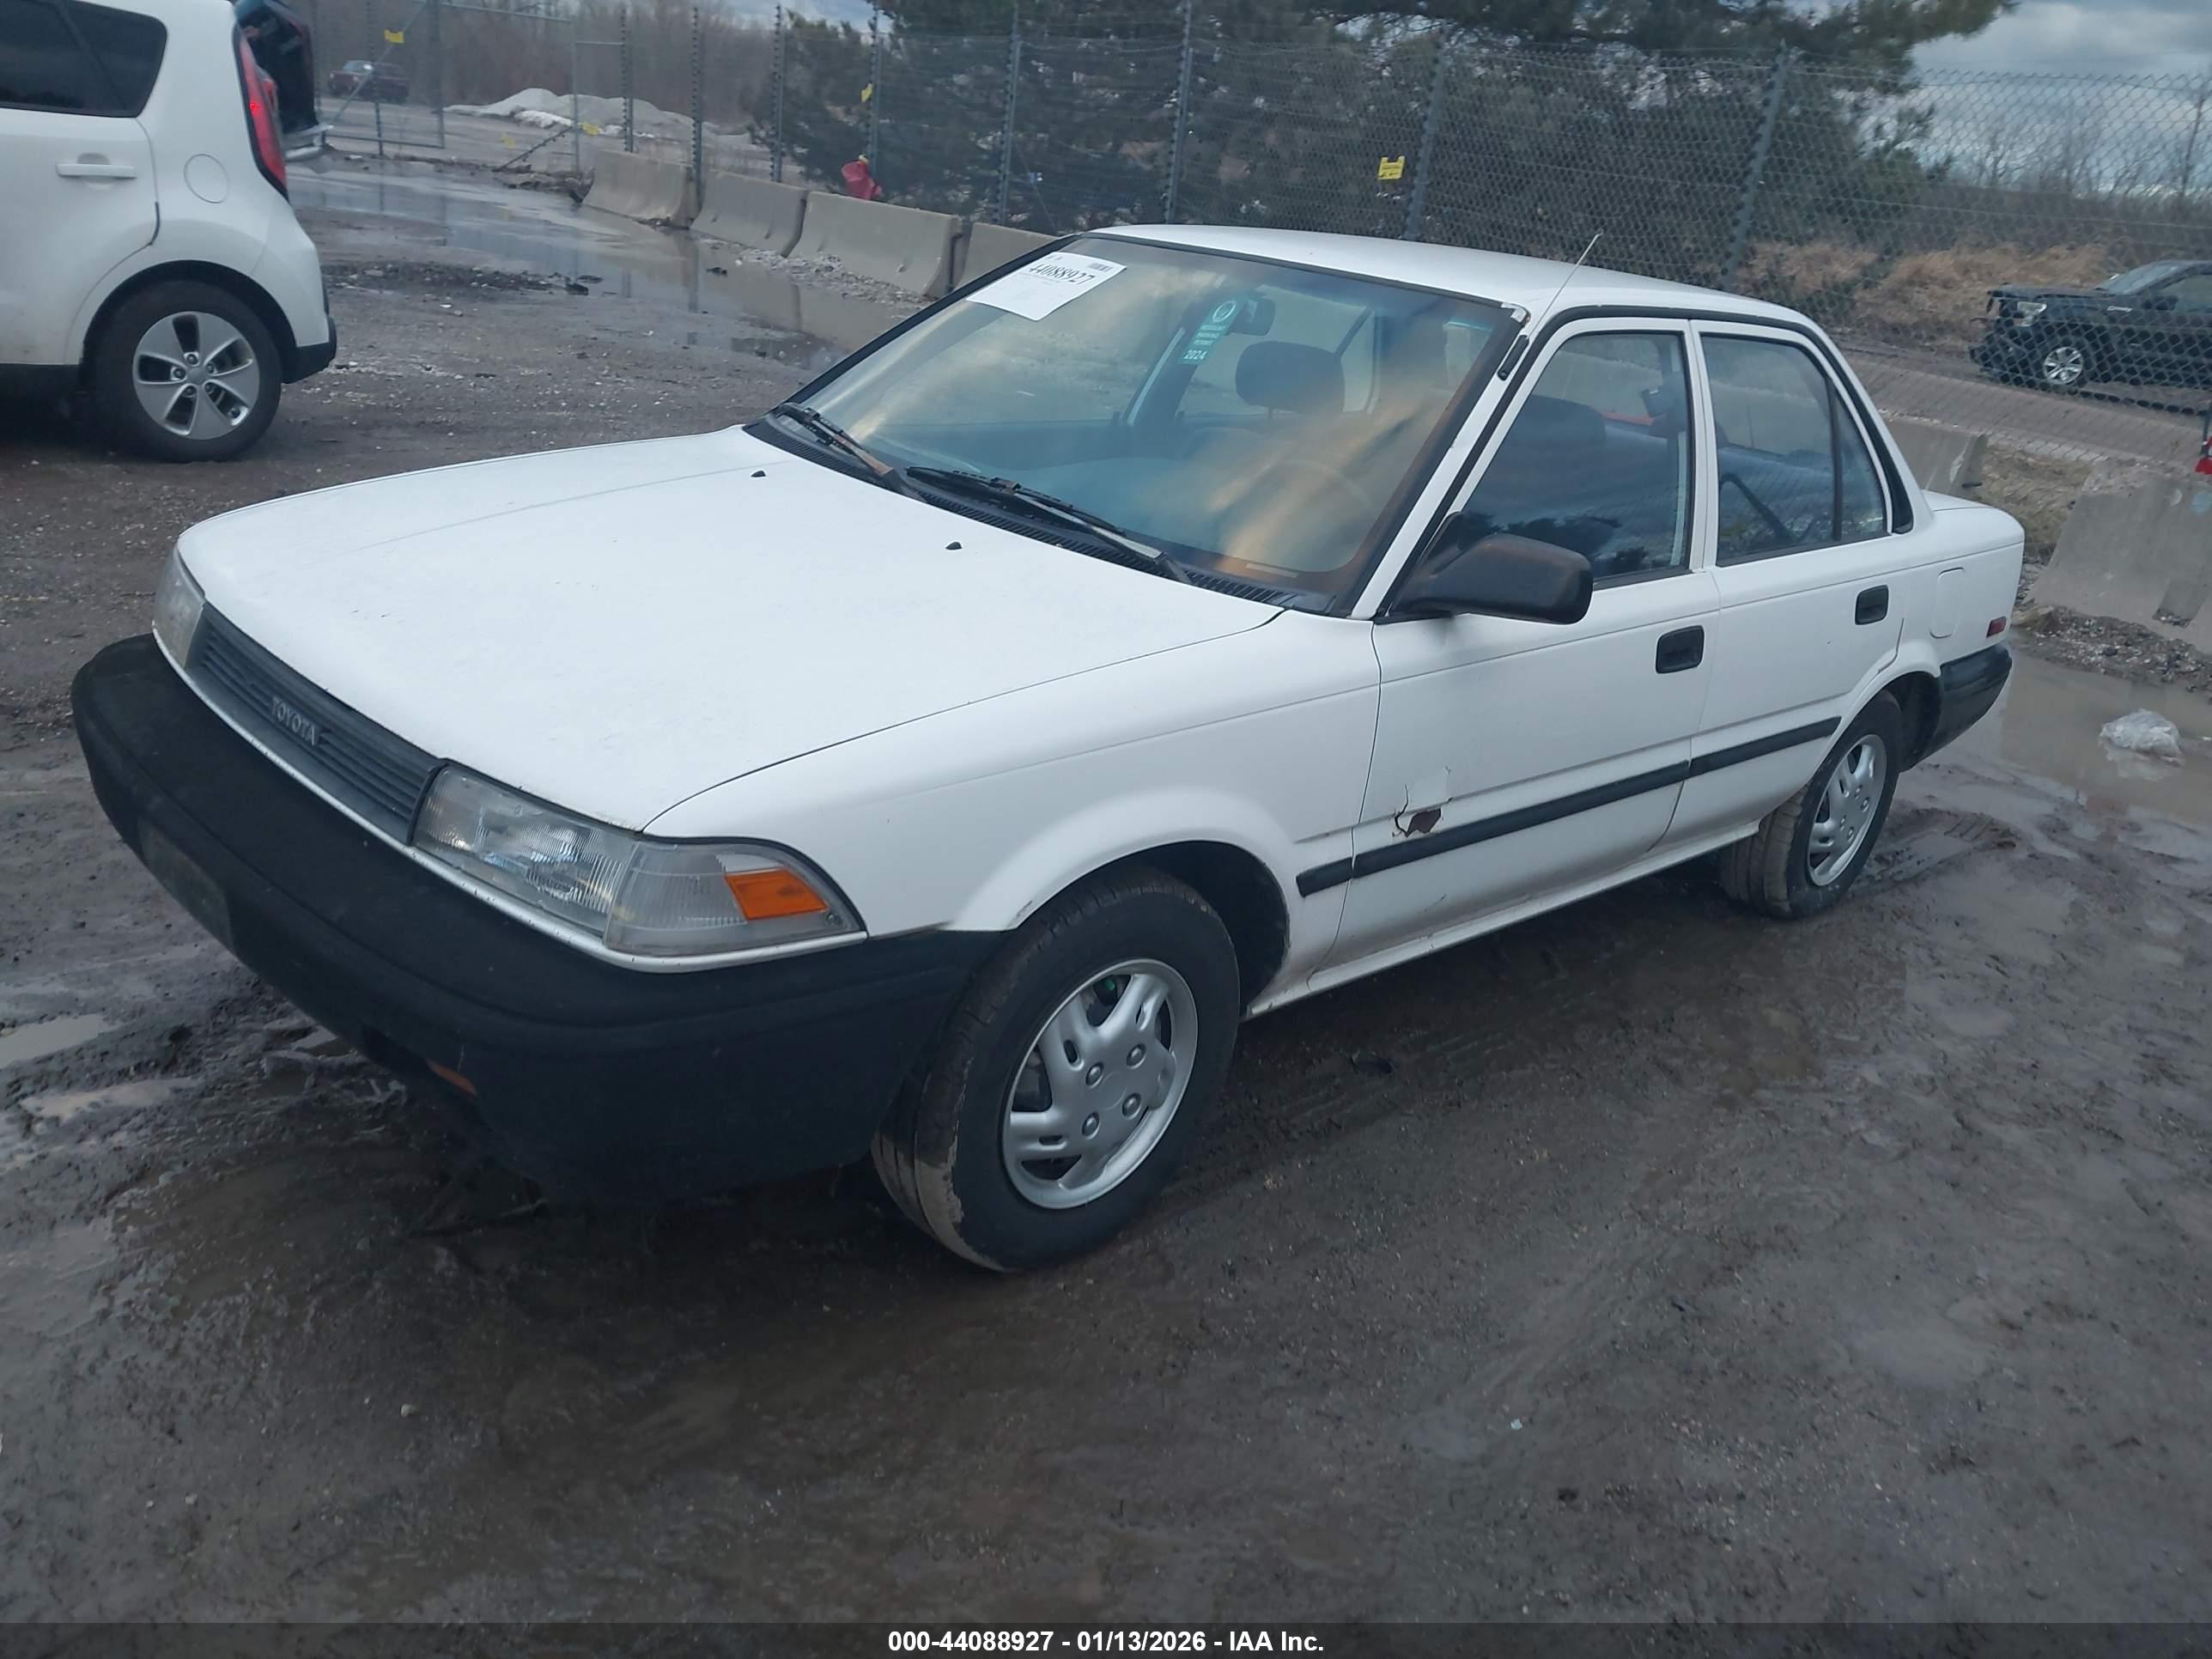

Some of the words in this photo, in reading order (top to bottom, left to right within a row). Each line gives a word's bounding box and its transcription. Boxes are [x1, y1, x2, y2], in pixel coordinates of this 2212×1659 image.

[1030, 263, 1096, 285] 44088927
[1183, 349, 1208, 361] 2024
[271, 696, 316, 746] TOYOTA
